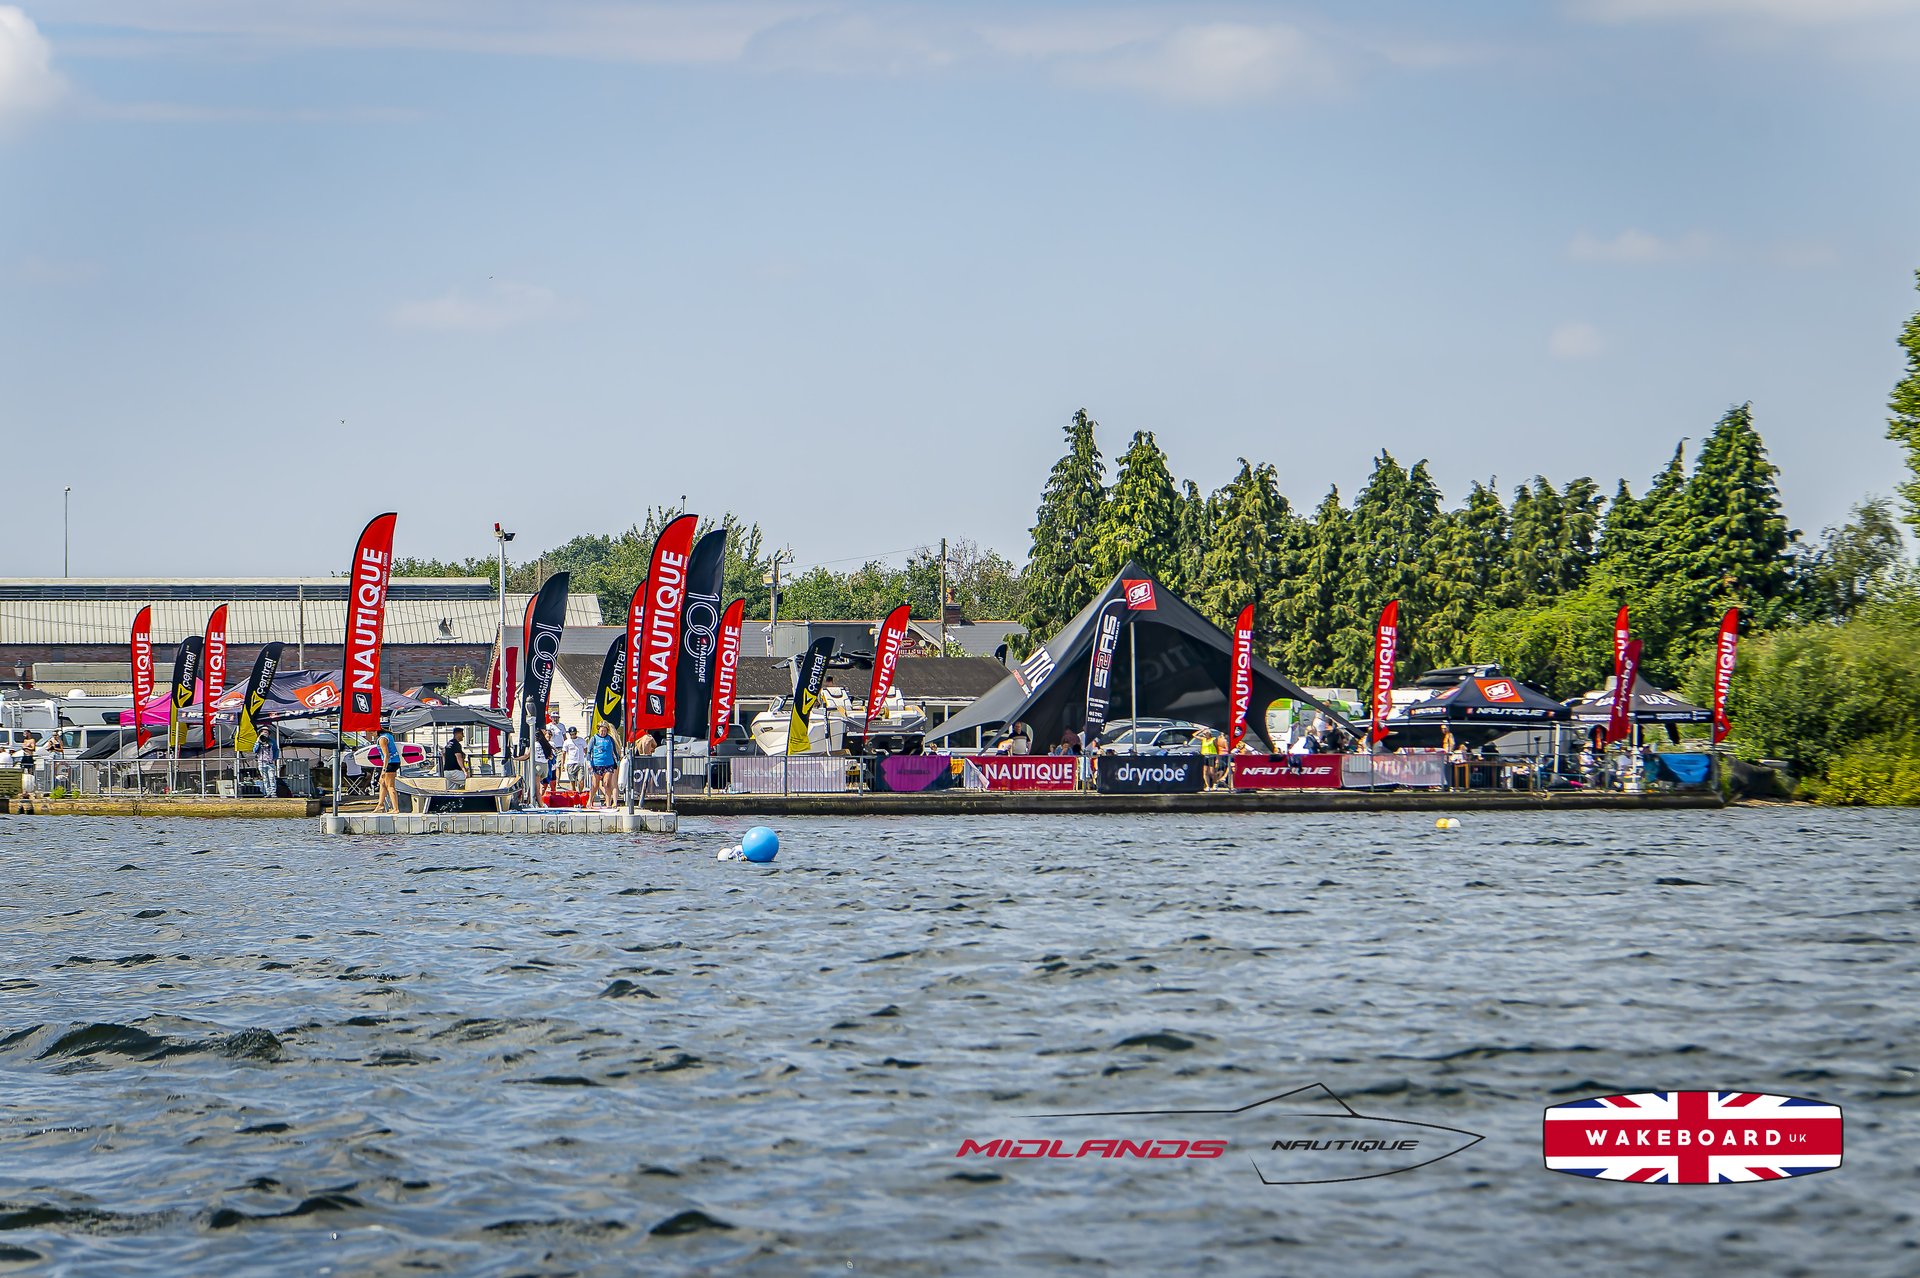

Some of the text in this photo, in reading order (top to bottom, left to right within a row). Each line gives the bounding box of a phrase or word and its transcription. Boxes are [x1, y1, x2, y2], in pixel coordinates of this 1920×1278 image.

[353, 547, 382, 690] NAUTIQUE
[646, 550, 683, 693] NAUTIQUE
[136, 632, 151, 710] AUTIQUE
[182, 651, 196, 687] central
[257, 657, 273, 694] central
[611, 650, 626, 691] central
[699, 644, 708, 683] NAUTIQUE
[718, 625, 739, 723] NAUTIQUE
[808, 653, 824, 692] central
[1236, 629, 1251, 724] NAUTIQUE
[1377, 626, 1394, 720] NAUTIQUE
[1718, 631, 1734, 716] AUTIQUE
[1476, 707, 1545, 716] NAUTIQUE
[985, 763, 1073, 781] NAUTIQUE
[1118, 763, 1186, 786] dryrobe
